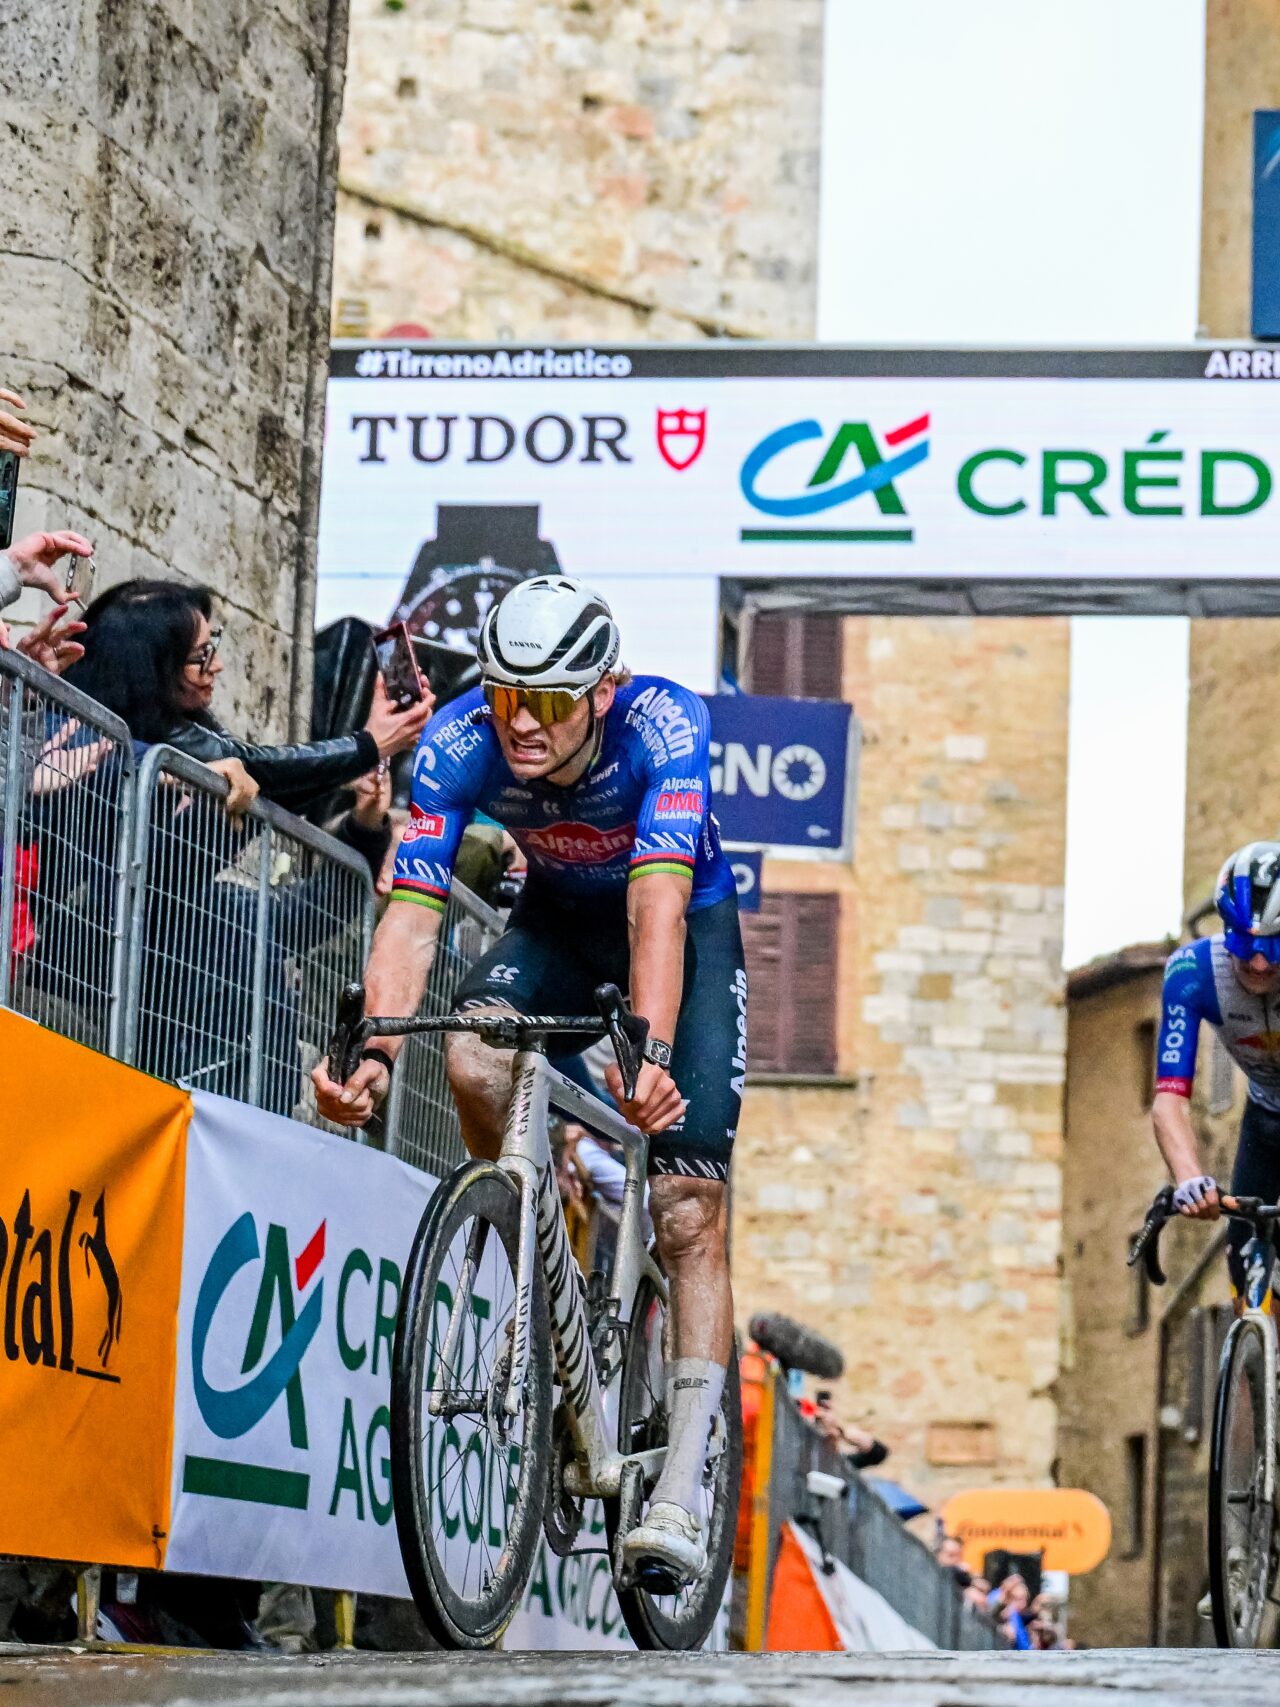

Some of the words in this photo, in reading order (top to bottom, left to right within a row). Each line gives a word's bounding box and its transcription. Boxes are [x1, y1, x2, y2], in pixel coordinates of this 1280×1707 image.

[355, 349, 633, 379] #TirrenoAdriatico
[351, 414, 632, 464] TUDOR
[445, 729, 484, 762] TECH
[631, 686, 699, 761] Alpecin
[1161, 1003, 1187, 1065] BOSS
